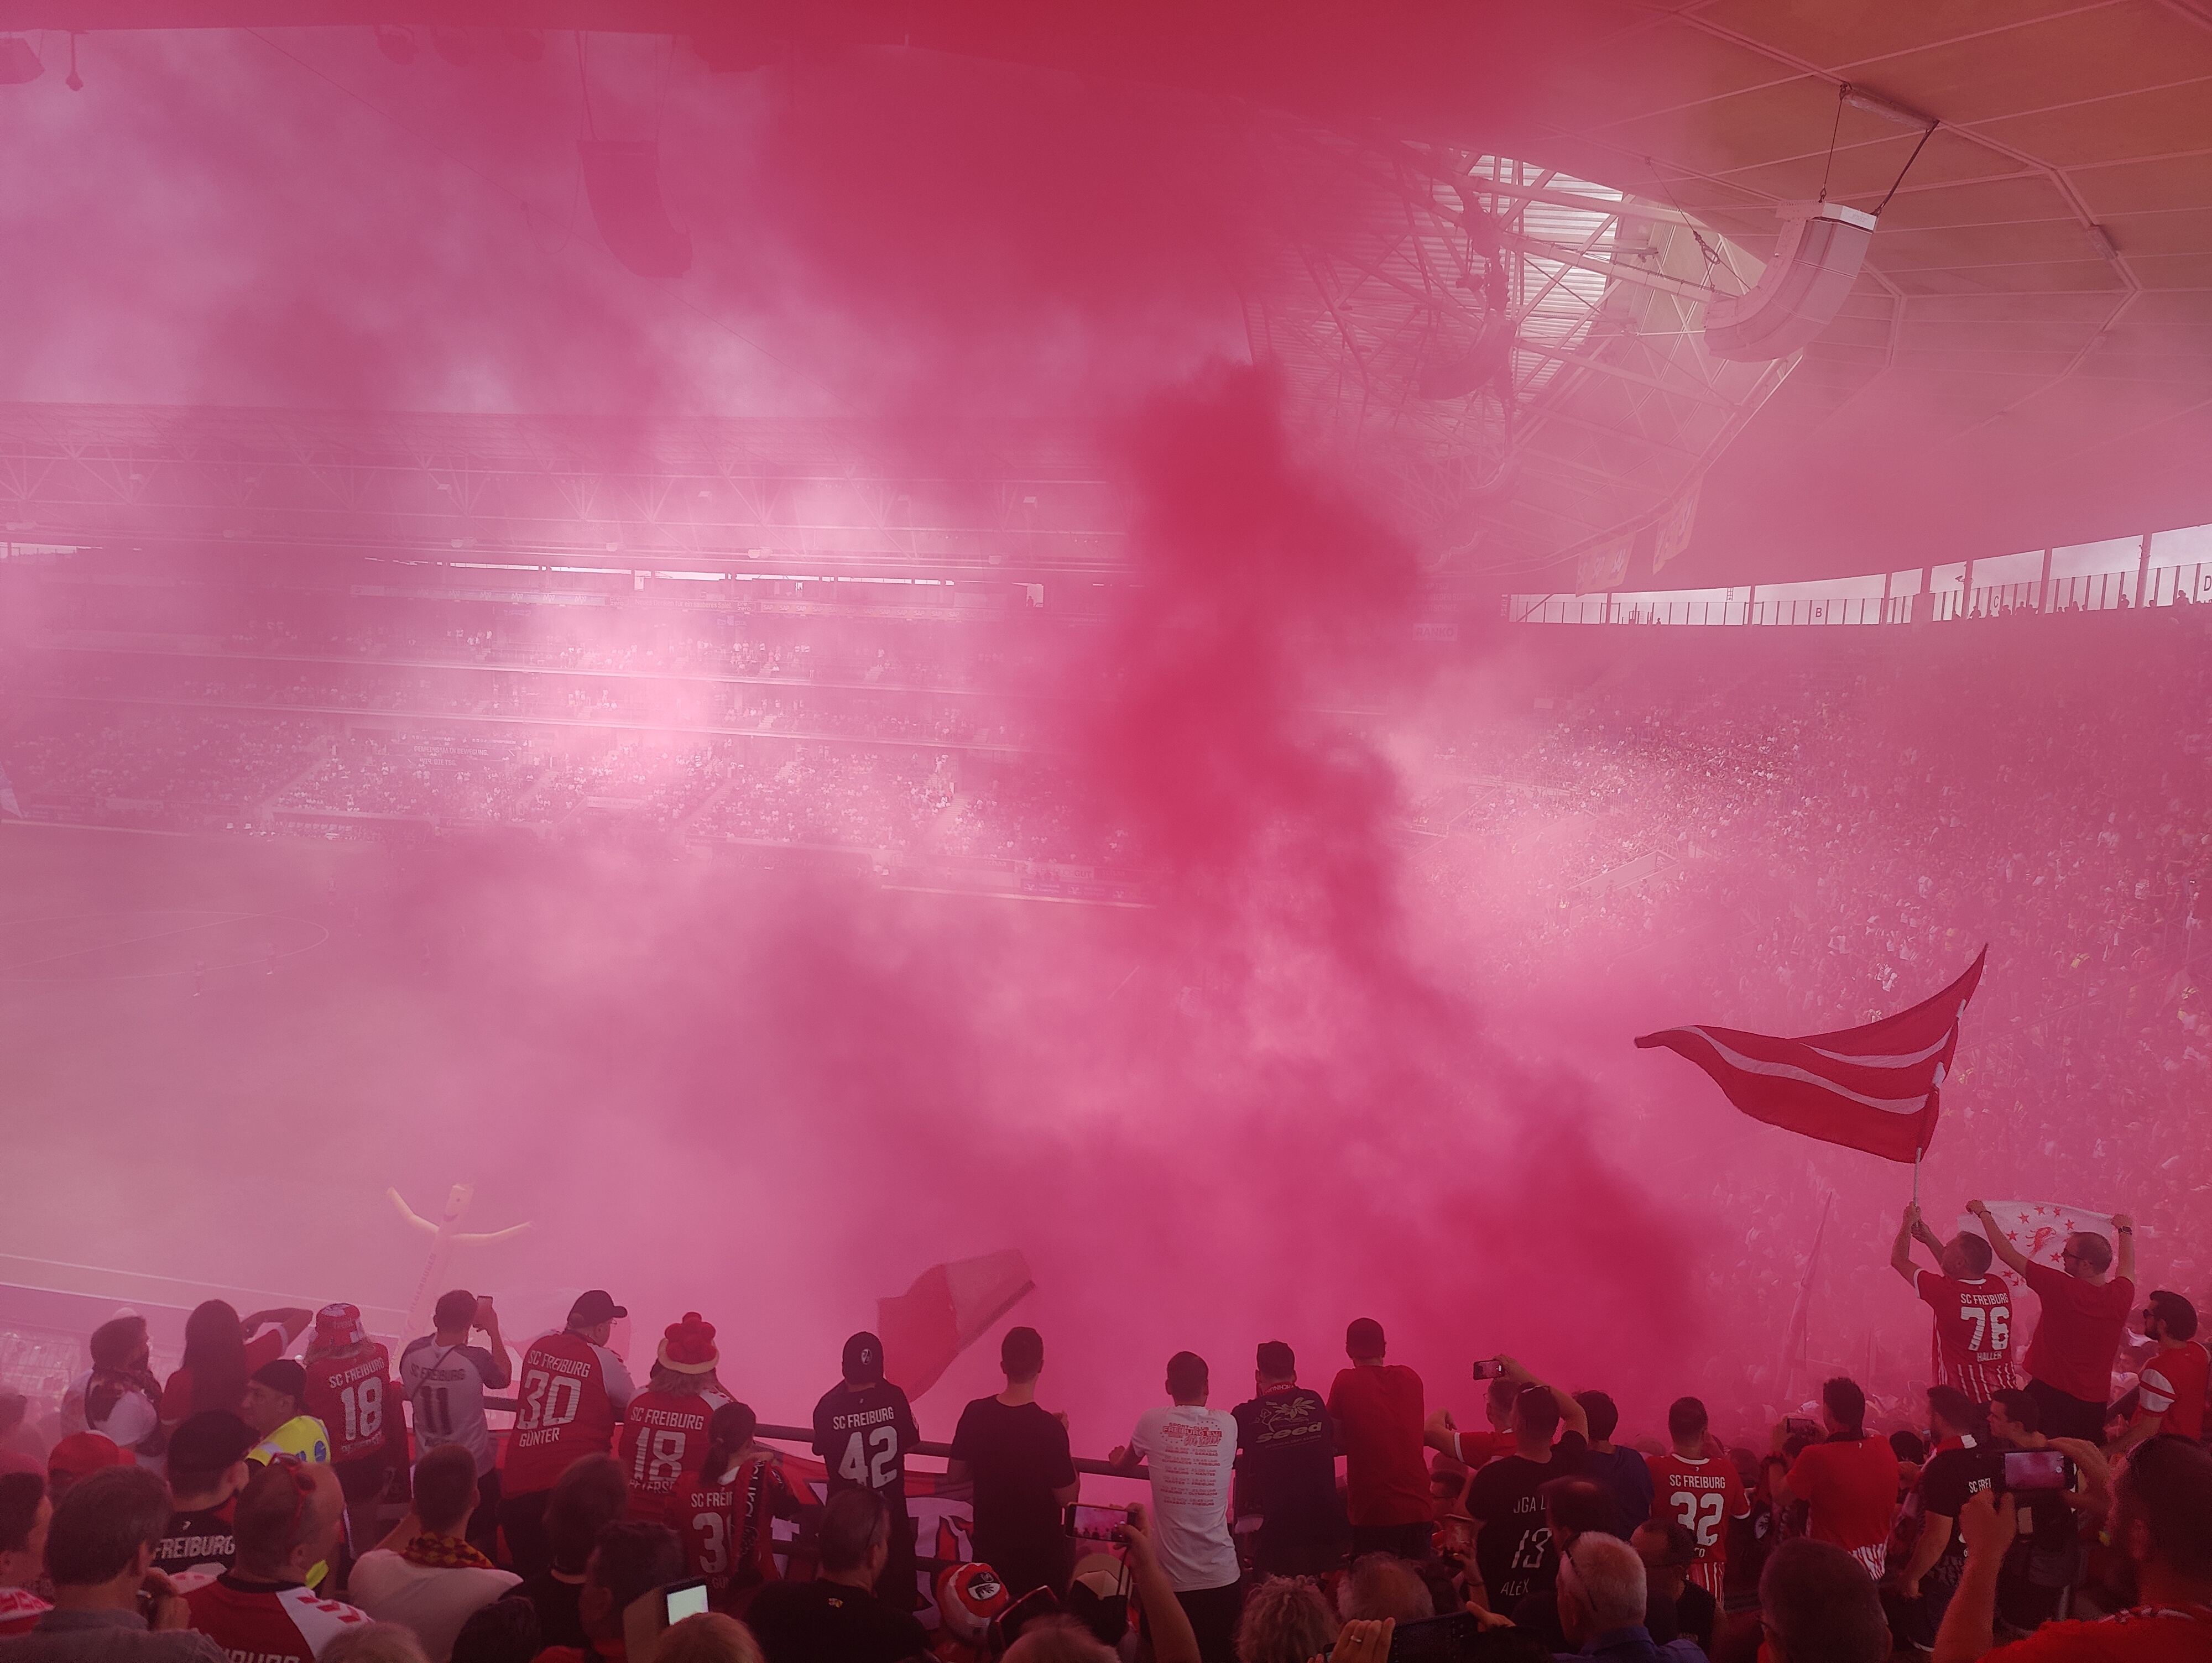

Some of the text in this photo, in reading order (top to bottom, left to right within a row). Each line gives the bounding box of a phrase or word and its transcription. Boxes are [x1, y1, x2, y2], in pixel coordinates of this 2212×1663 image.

[2204, 576, 2211, 591] D
[1816, 608, 1822, 617] B
[1994, 595, 1999, 608] C
[1960, 1293, 2009, 1305] SC FREIBURG
[1960, 1306, 2010, 1351] 76
[329, 1357, 385, 1388] SC FREIBURG
[528, 1350, 591, 1378] SC FREIBURG
[341, 1376, 383, 1441] 18
[420, 1385, 452, 1435] 11
[517, 1369, 581, 1430] 30
[630, 1406, 704, 1430] SC FREIBURG
[833, 1406, 894, 1430] SC FREIBURG
[1163, 1426, 1204, 1436] FREIBURG
[1256, 1421, 1322, 1443] seed
[634, 1426, 686, 1482] 18
[838, 1425, 898, 1488] 42
[1670, 1474, 1725, 1489] SC FREIBURG
[1968, 1478, 1991, 1493] SC FREI
[691, 1493, 704, 1508] SC
[1514, 1496, 1536, 1514] JGA
[1670, 1492, 1724, 1546] 32
[1511, 1528, 1553, 1568] 13
[1500, 1577, 1530, 1596] ALEX
